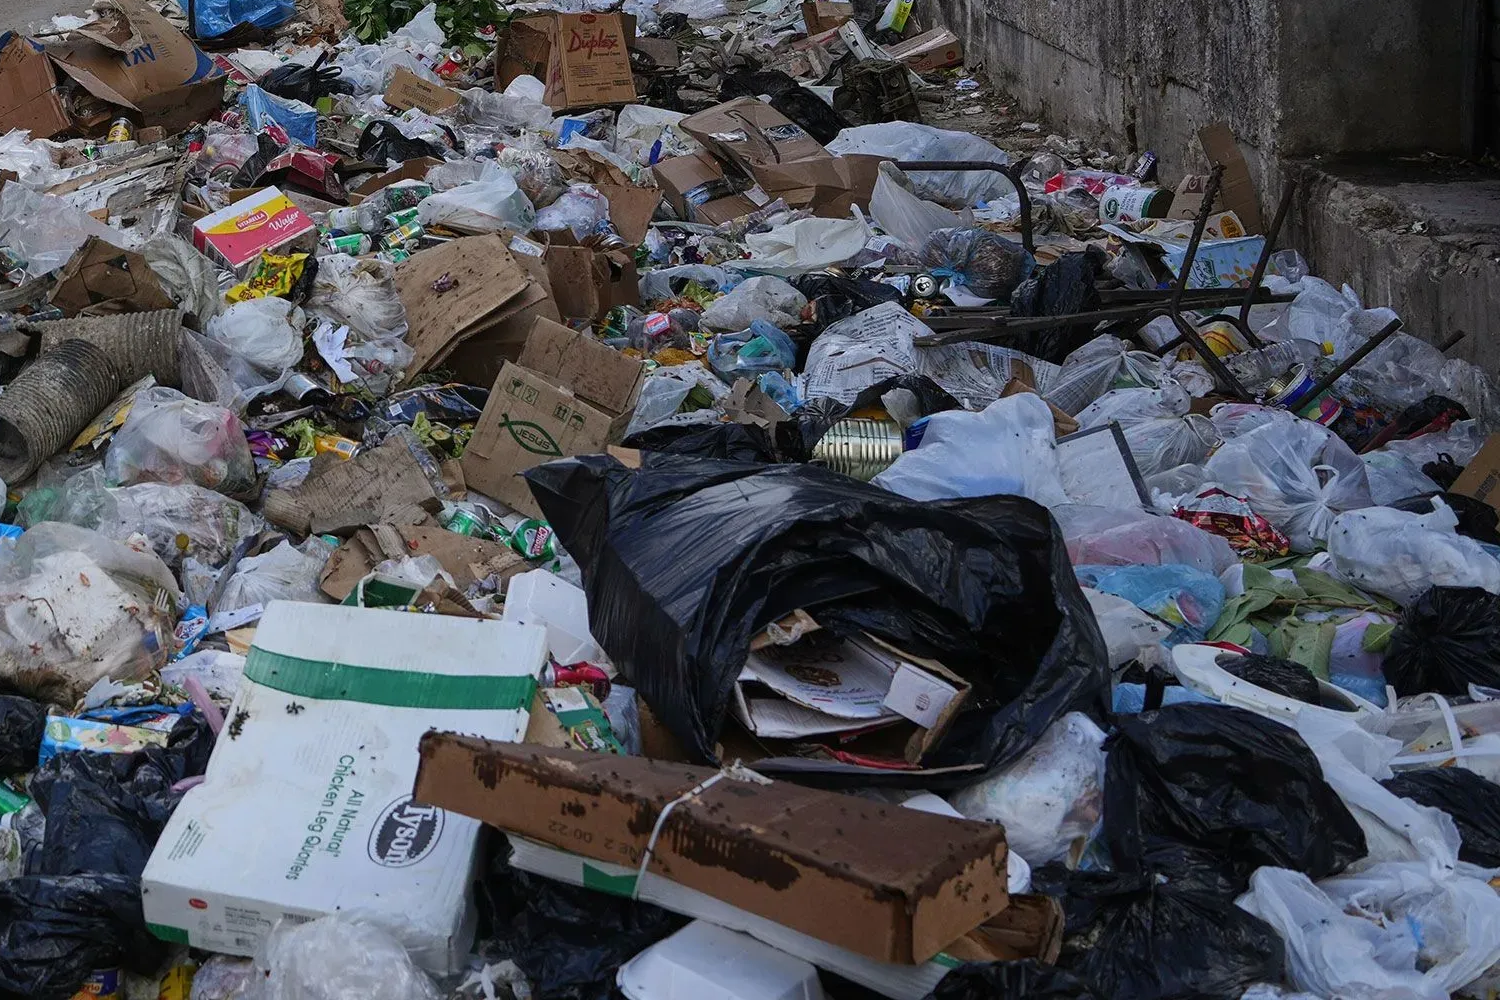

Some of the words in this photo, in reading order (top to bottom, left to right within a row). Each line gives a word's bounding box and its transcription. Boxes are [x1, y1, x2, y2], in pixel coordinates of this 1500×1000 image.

[567, 28, 619, 60] Duplex
[268, 211, 299, 231] Wafer
[515, 429, 550, 450] JESUS
[321, 754, 355, 808] Chicken
[346, 789, 365, 808] All
[307, 810, 333, 833] Leg
[383, 803, 436, 864] Tyson
[285, 835, 322, 881] Quarters
